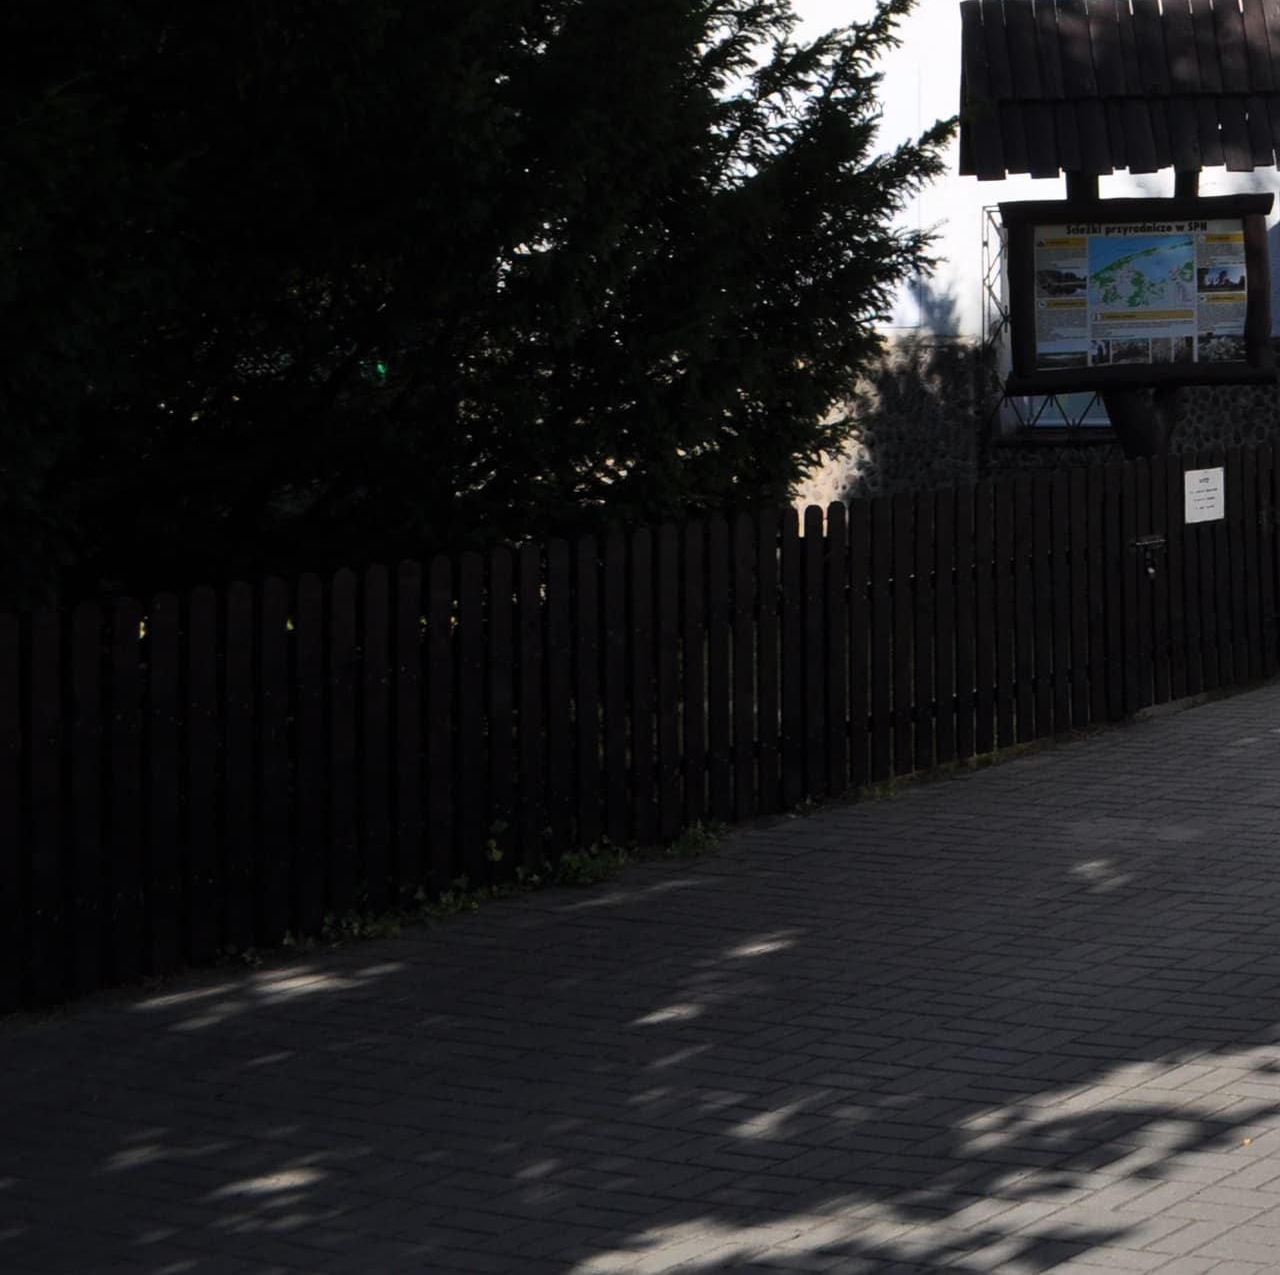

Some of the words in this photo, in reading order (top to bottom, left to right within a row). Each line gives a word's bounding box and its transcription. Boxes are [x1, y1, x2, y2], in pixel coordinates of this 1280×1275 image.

[1105, 222, 1173, 236] przyrodnicze
[1175, 224, 1185, 232] w
[1188, 222, 1207, 232] SPN
